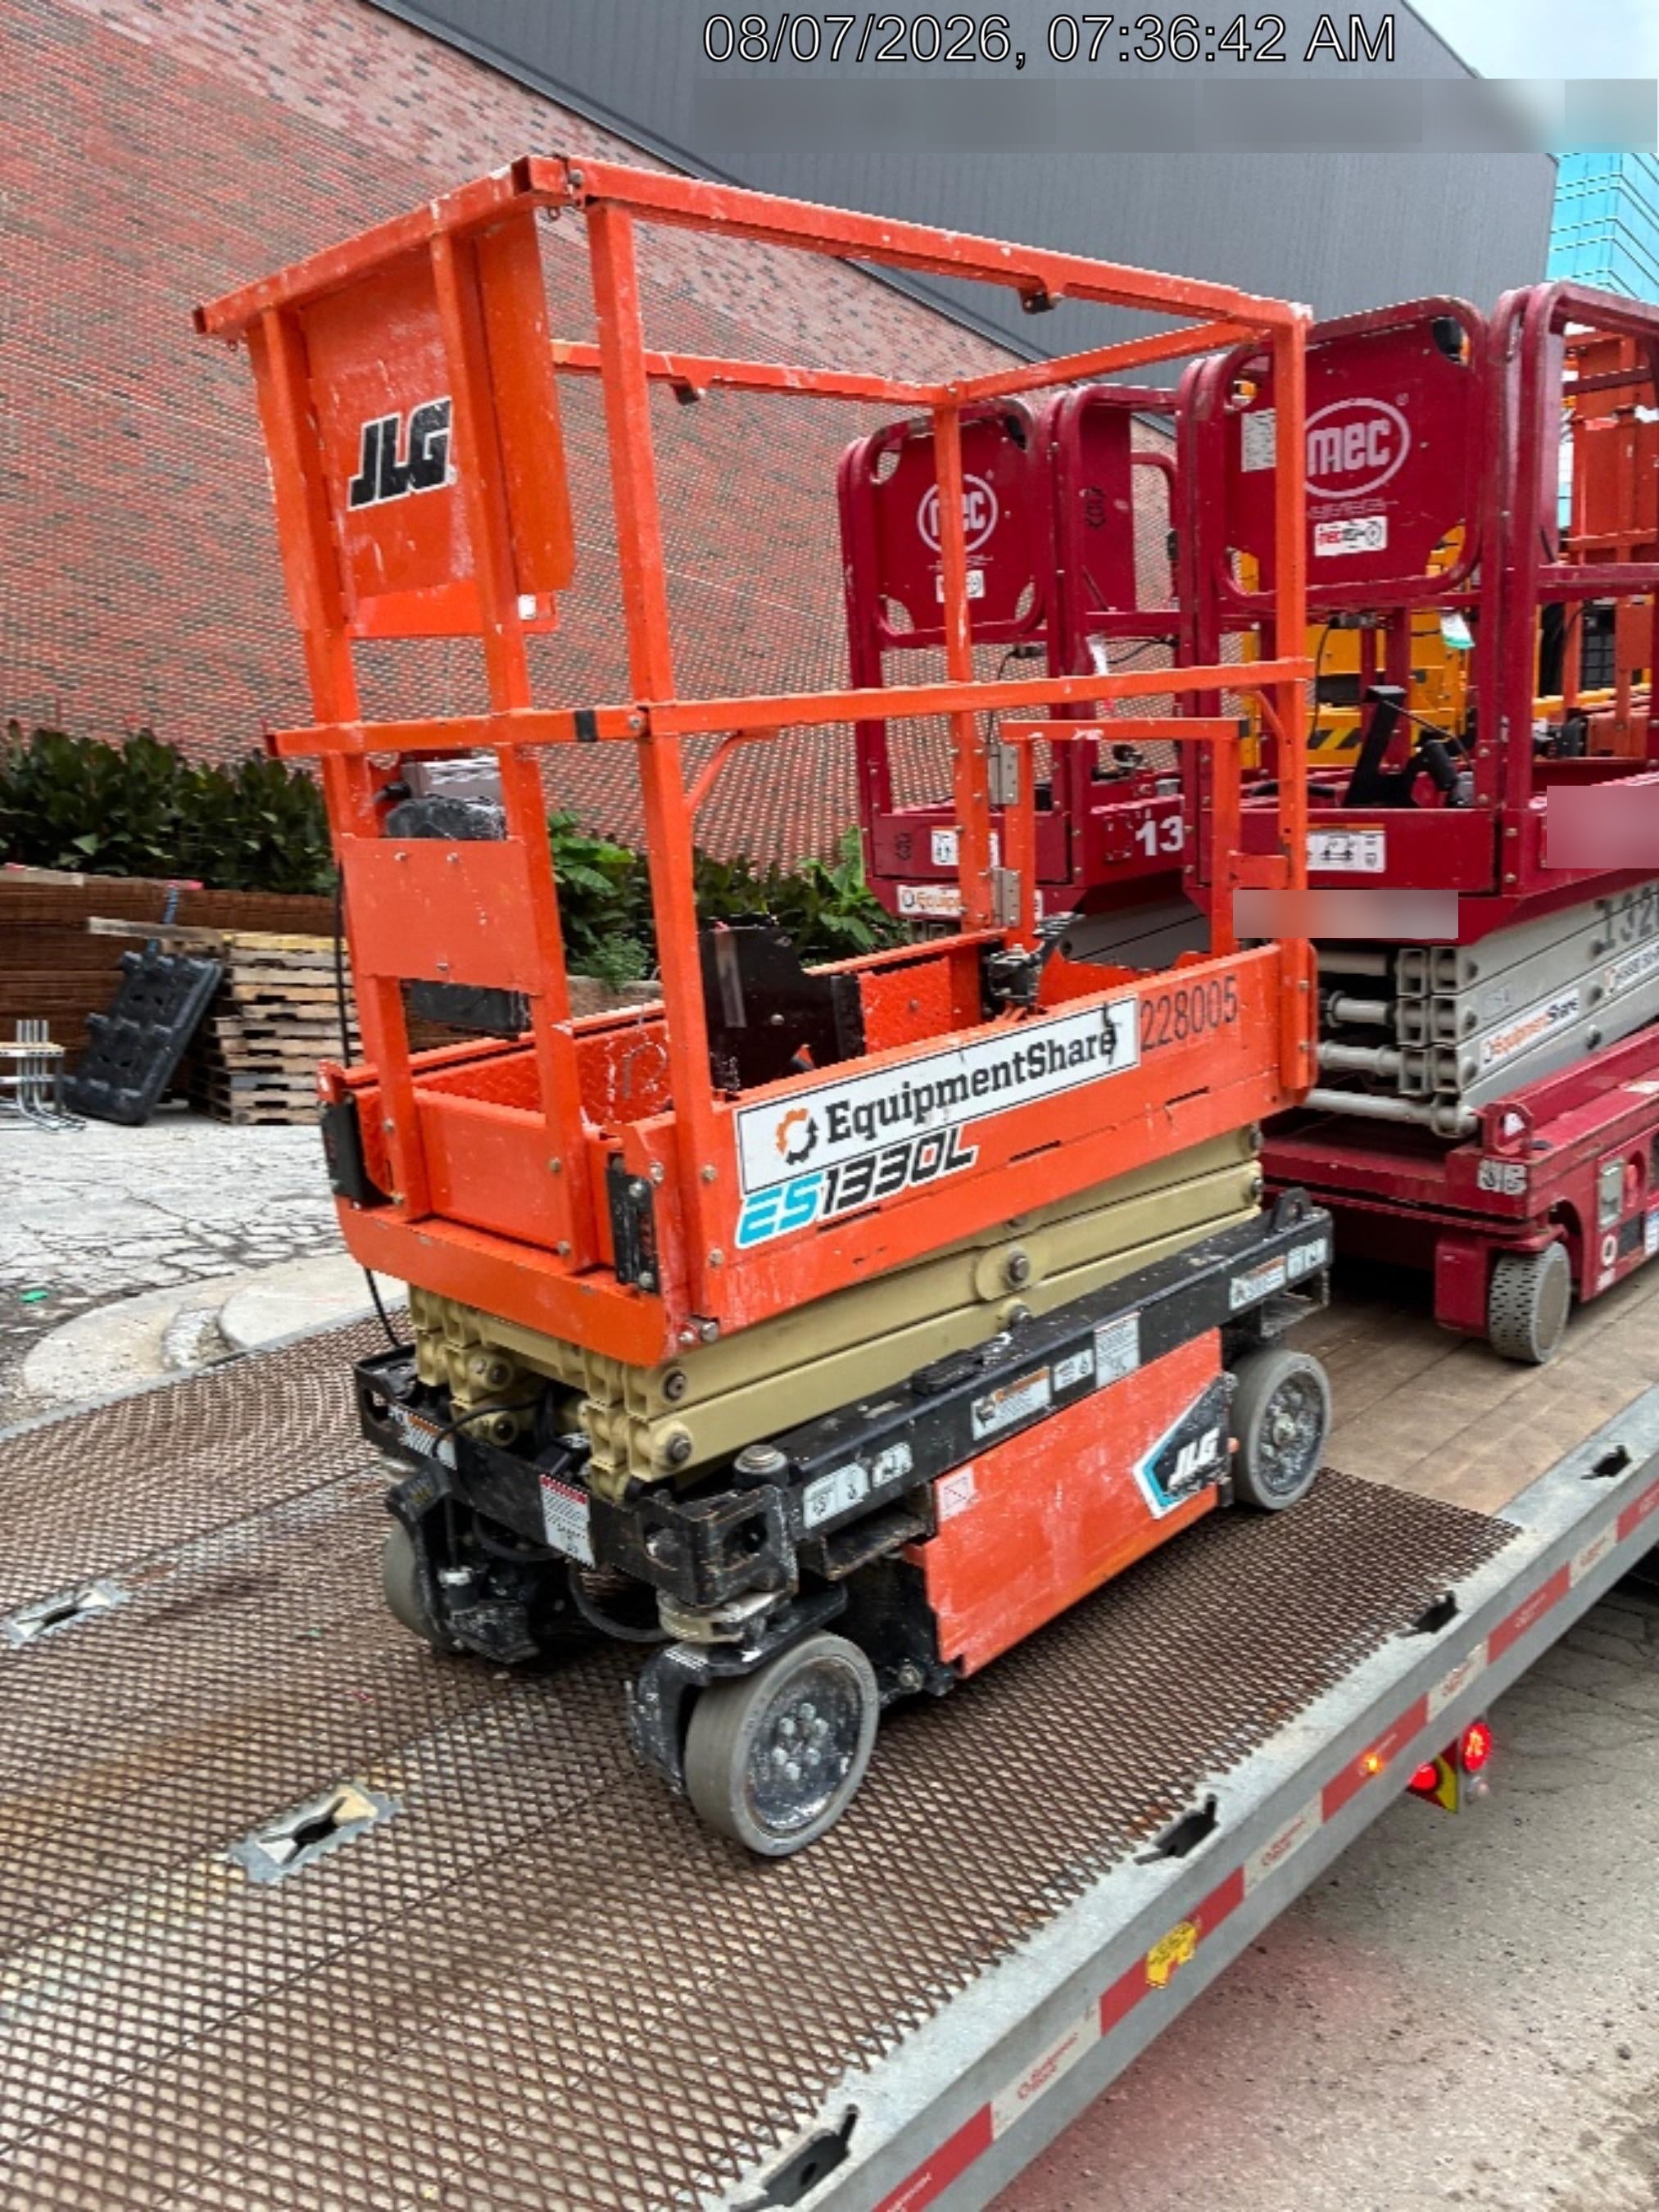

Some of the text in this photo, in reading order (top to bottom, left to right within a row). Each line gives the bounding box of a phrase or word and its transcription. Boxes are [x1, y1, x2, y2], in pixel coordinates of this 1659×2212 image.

[349, 397, 452, 511] JLG
[1307, 419, 1390, 477] mec
[1135, 815, 1184, 857] 13
[1140, 973, 1237, 1053] 228005
[825, 1027, 1117, 1145] EquipmentShare
[737, 1126, 977, 1246] ES1330L
[1167, 1427, 1220, 1487] JLG
